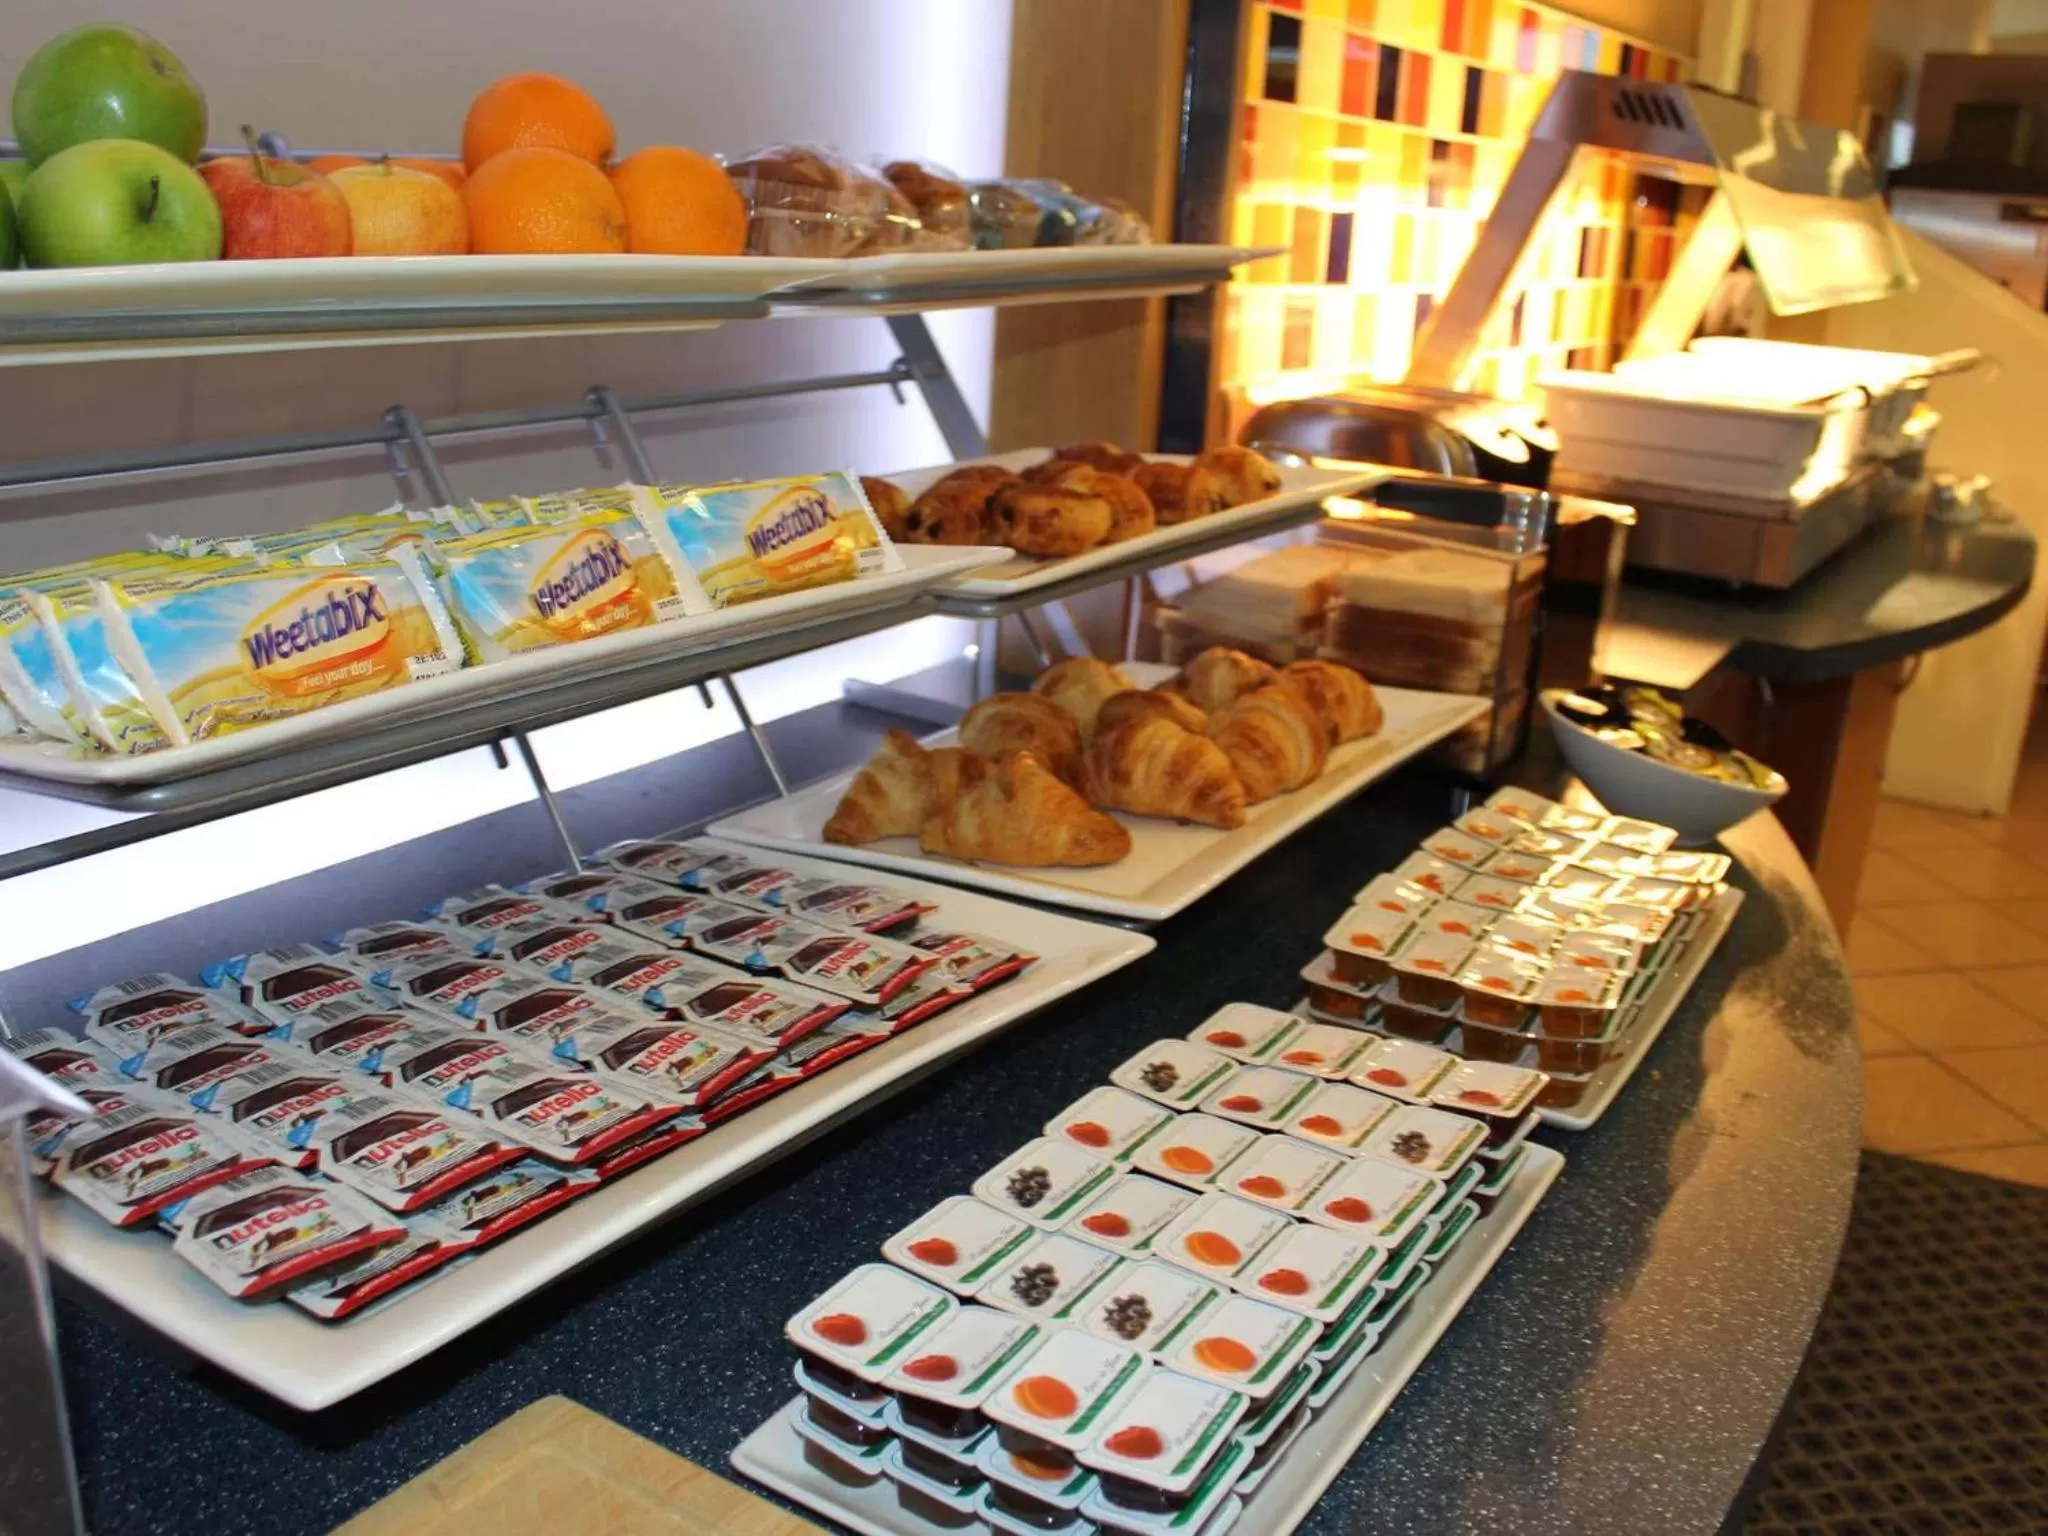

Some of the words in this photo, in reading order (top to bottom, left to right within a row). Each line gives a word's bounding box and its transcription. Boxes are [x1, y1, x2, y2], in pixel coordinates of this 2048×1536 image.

[745, 494, 838, 558] Weetabix
[532, 539, 632, 618] Weetabix
[244, 583, 386, 669] Weetabix
[531, 932, 602, 966] nutella
[815, 942, 871, 978] nutella
[281, 981, 362, 1012] nutella
[430, 967, 505, 1001] nutella
[611, 958, 683, 993] nutella
[115, 1001, 209, 1031] nutella
[514, 998, 595, 1037] nutella
[420, 1045, 509, 1088] nutella
[628, 1030, 698, 1074] nutella
[252, 1085, 348, 1127] nutella
[516, 1082, 602, 1128] nutella
[89, 1126, 199, 1178] nutella
[353, 1122, 450, 1170] nutella
[212, 1196, 331, 1249] nutella
